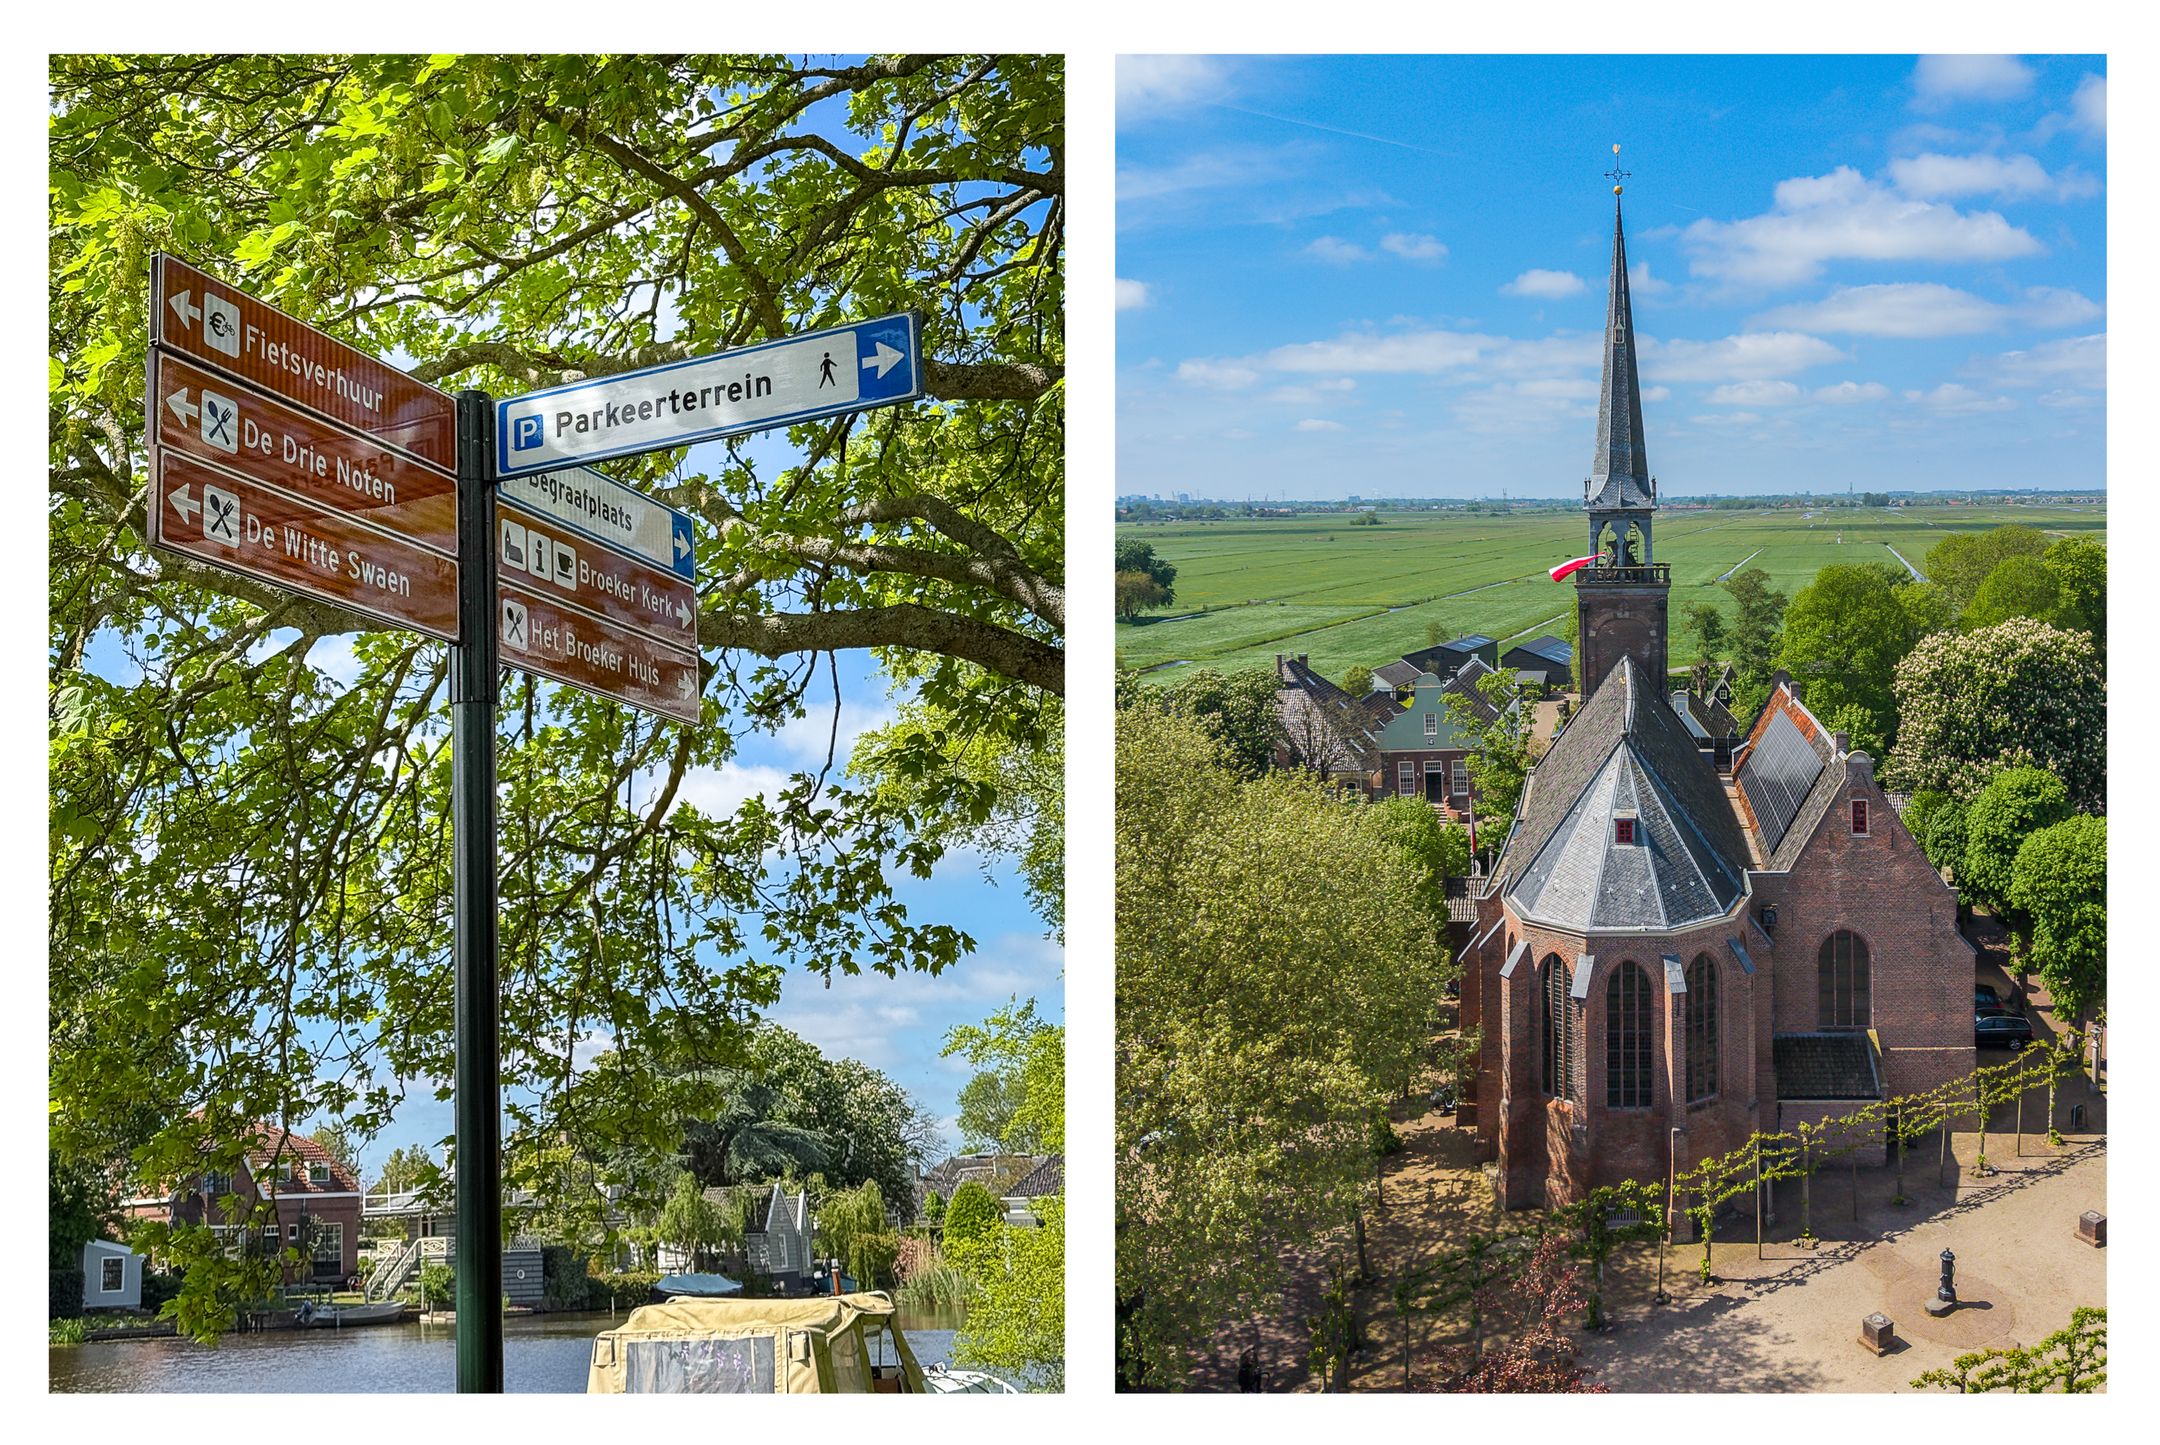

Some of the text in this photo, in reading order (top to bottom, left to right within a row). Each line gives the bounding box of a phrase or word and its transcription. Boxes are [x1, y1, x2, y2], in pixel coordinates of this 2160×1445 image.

[246, 324, 384, 413] Fietsverhuur
[519, 418, 538, 447] P
[556, 372, 772, 438] Parkeerterrein
[244, 418, 273, 455] De
[283, 434, 327, 478] Drie
[336, 456, 395, 505] Noten
[247, 513, 410, 598] De Witte Swaen
[580, 559, 673, 619] Broeker Kerk
[531, 618, 660, 686] Het Broeker Huis
